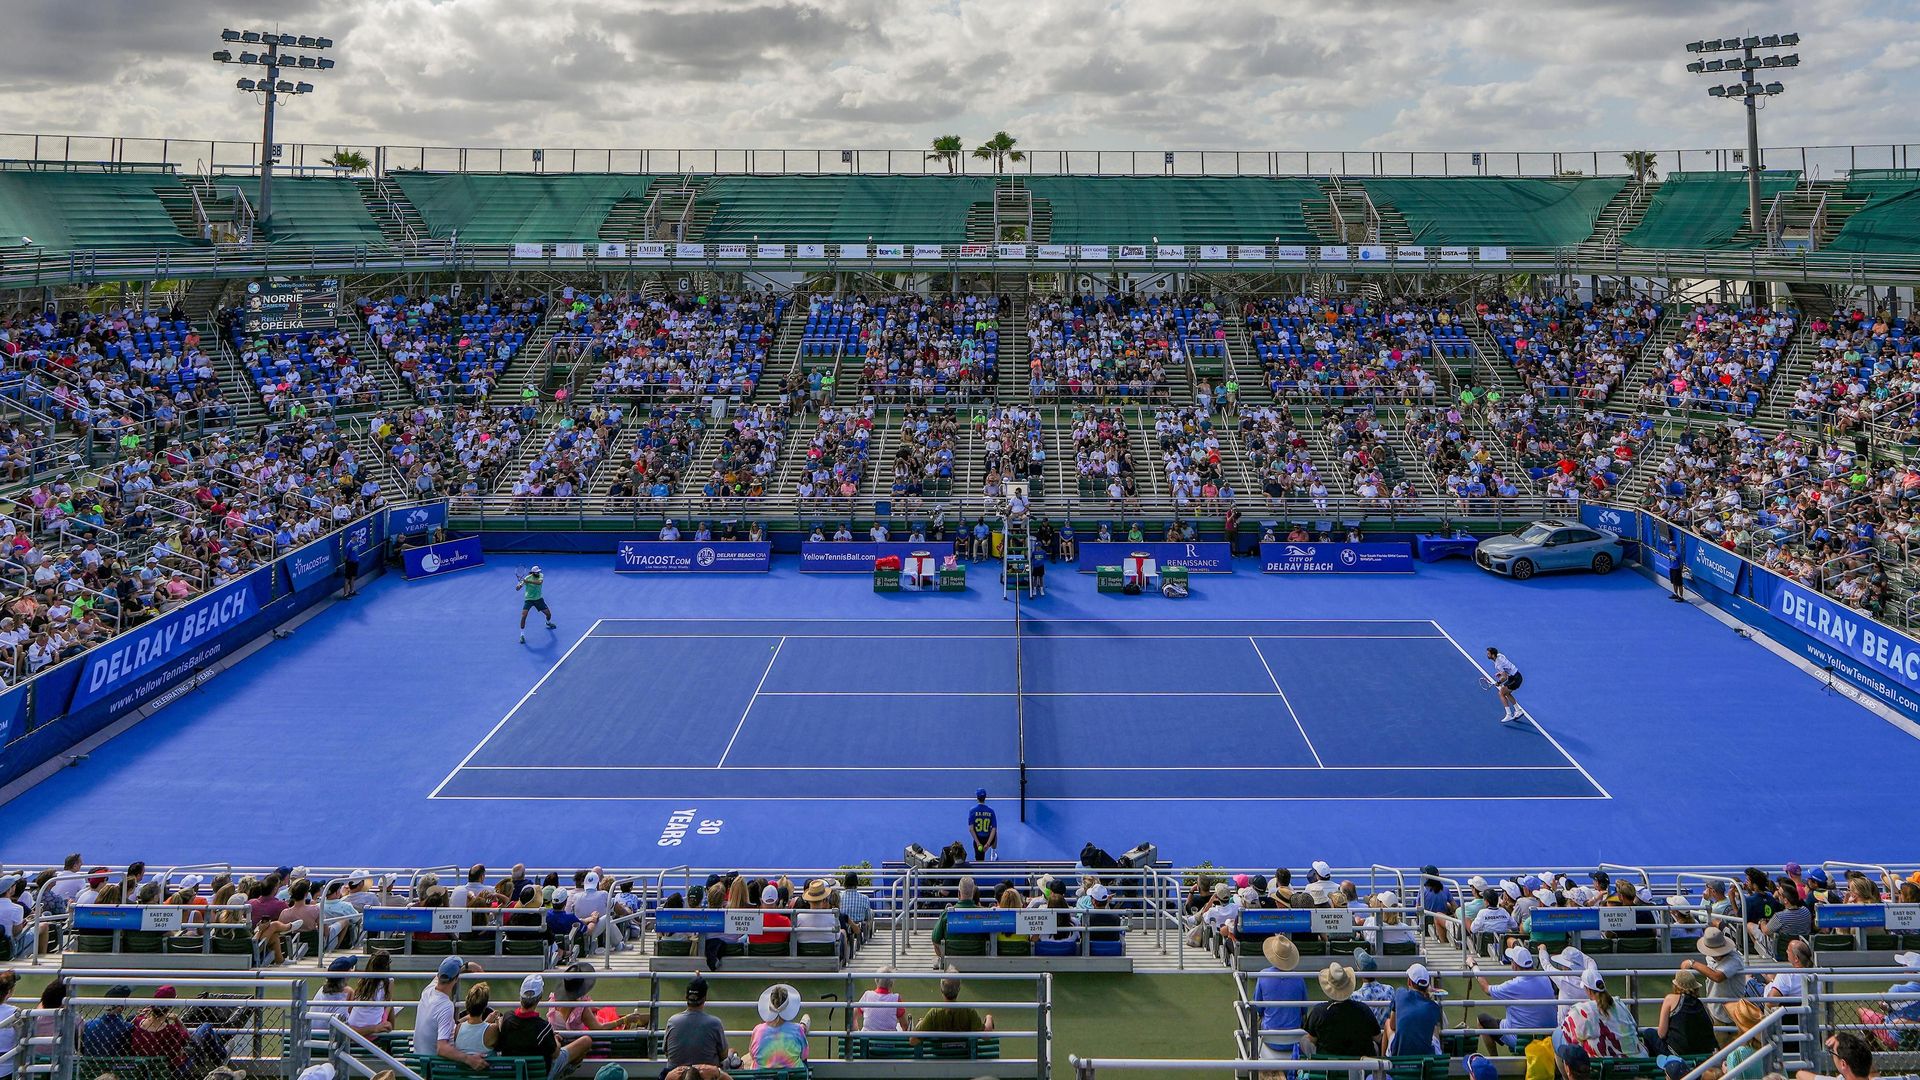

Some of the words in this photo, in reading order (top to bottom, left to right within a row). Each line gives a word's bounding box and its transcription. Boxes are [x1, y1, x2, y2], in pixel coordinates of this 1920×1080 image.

[879, 248, 901, 256] tervis
[453, 285, 460, 296] F
[680, 279, 688, 290] G
[908, 279, 915, 291] H
[1339, 281, 1344, 291] J
[262, 294, 303, 304] NORRIE
[261, 320, 304, 330] OPELKA
[1599, 524, 1622, 533] YEARS
[450, 550, 468, 564] gallery
[803, 553, 876, 561] YellowTennisBall.com
[1186, 544, 1199, 557] R
[1267, 563, 1301, 571] DELRAY
[1303, 563, 1333, 571] BEACH
[89, 622, 179, 693] DELRAY
[180, 588, 247, 645] BEACH
[1782, 590, 1857, 647] DELRAY
[1862, 628, 1920, 681] BEAC
[110, 643, 221, 714] www.YellowTennisBall.com
[1807, 644, 1919, 712] www.YellowTennisBall.com
[151, 684, 189, 709] CELEBRATING
[196, 669, 215, 682] YEARS
[1849, 689, 1858, 698] 30
[1858, 694, 1878, 709] YEARS
[657, 808, 698, 847] YEARS
[696, 819, 724, 835] 30
[975, 818, 991, 832] 30
